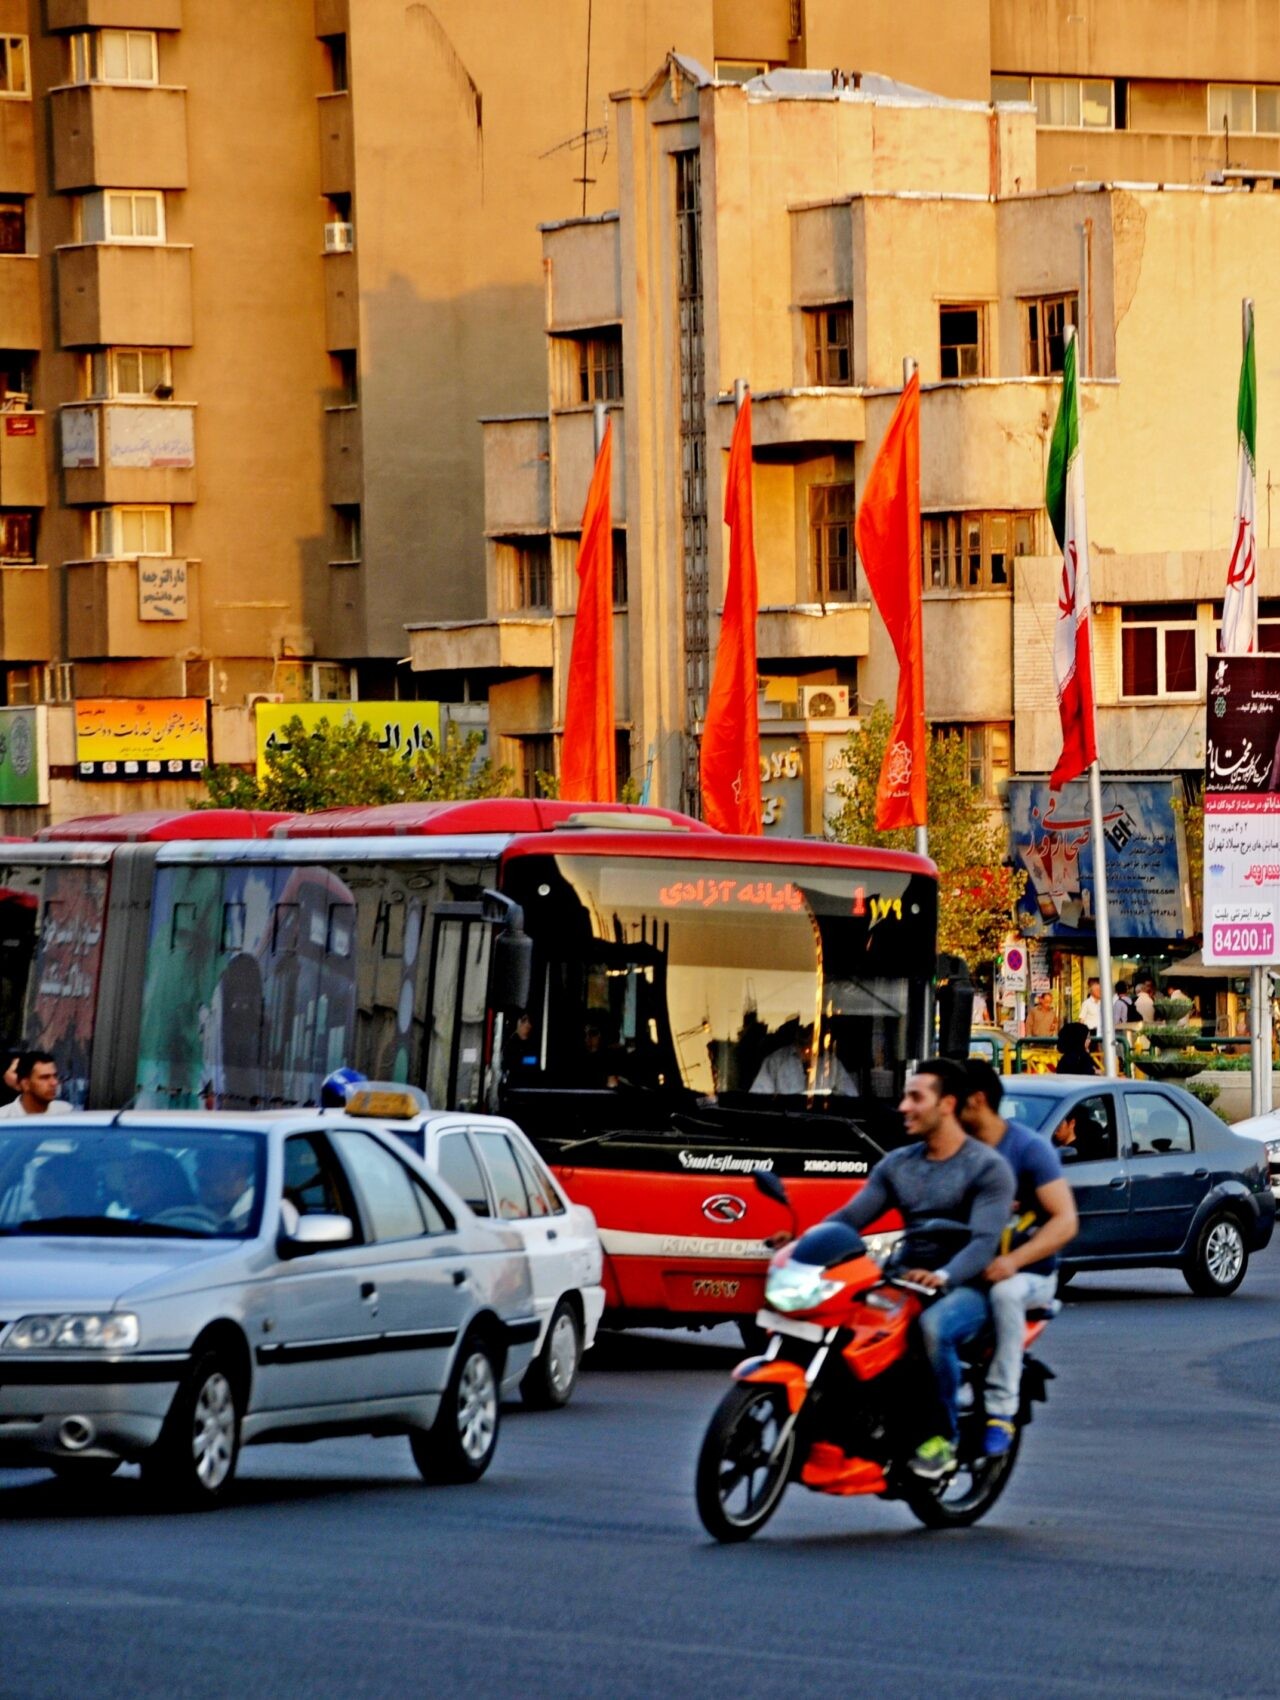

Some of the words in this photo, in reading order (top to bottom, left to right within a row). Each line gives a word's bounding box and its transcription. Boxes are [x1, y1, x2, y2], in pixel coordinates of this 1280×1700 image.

[78, 720, 112, 737] دولت
[113, 721, 152, 737] خدمات
[1208, 837, 1225, 852] تهران
[1226, 837, 1240, 850] میلاد
[1241, 842, 1252, 855] برج
[658, 879, 737, 908] آزادی
[737, 882, 803, 912] پایانه
[1215, 907, 1229, 921] بلیت
[1231, 907, 1253, 921] اینترنتی
[1254, 908, 1271, 920] خرید
[1215, 927, 1272, 952] 84200.ir
[662, 1236, 714, 1255] KING
